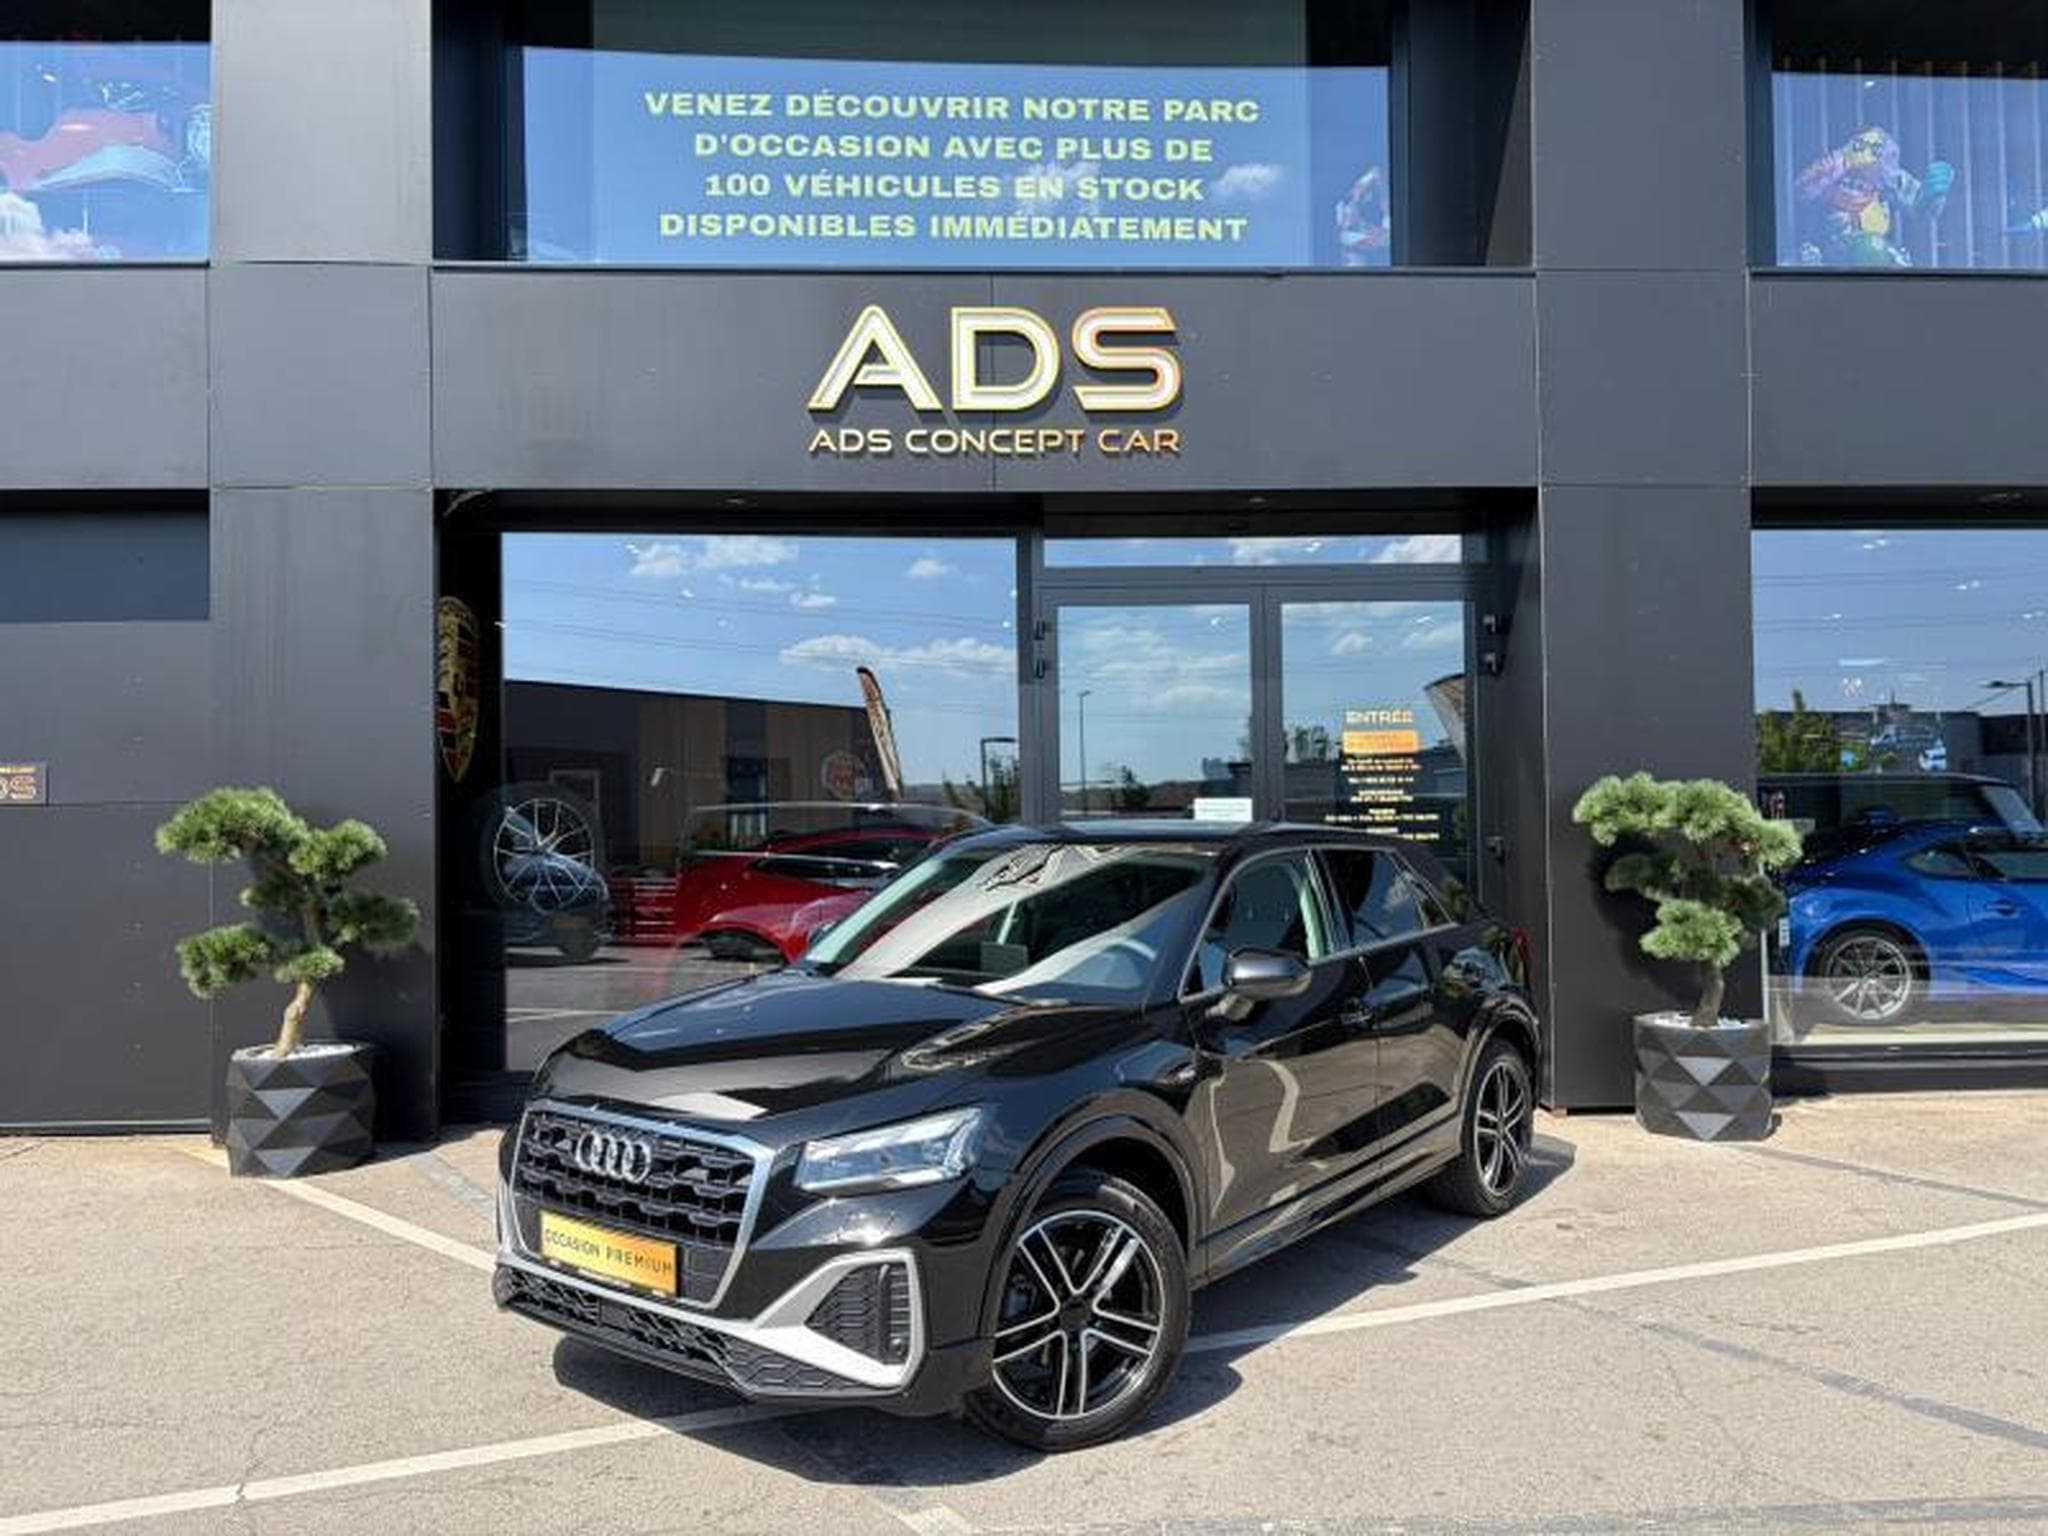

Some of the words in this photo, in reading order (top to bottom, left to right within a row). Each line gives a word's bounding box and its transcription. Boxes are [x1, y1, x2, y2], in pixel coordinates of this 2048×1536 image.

[645, 92, 772, 116] VENEZ
[785, 89, 1009, 120] DÉCOUVRIR
[1023, 96, 1150, 122] NOTRE
[1164, 99, 1259, 123] PARC
[695, 133, 930, 160] D'OCCASION
[943, 136, 1044, 161] AVEC
[1056, 137, 1151, 162] PLUS
[1164, 139, 1212, 162] DE
[705, 174, 770, 197] 100
[784, 168, 1000, 199] VÉHICULES
[1015, 176, 1064, 200] EN
[1077, 177, 1204, 202] STOCK
[659, 213, 915, 238] DISPONIBLES
[807, 304, 1182, 412] ADS
[808, 428, 893, 454] ADS
[905, 428, 1085, 454] CONCEPT
[1098, 428, 1181, 454] CAR
[544, 1228, 600, 1258] OCCASION
[606, 1246, 673, 1274] PREMIUM
